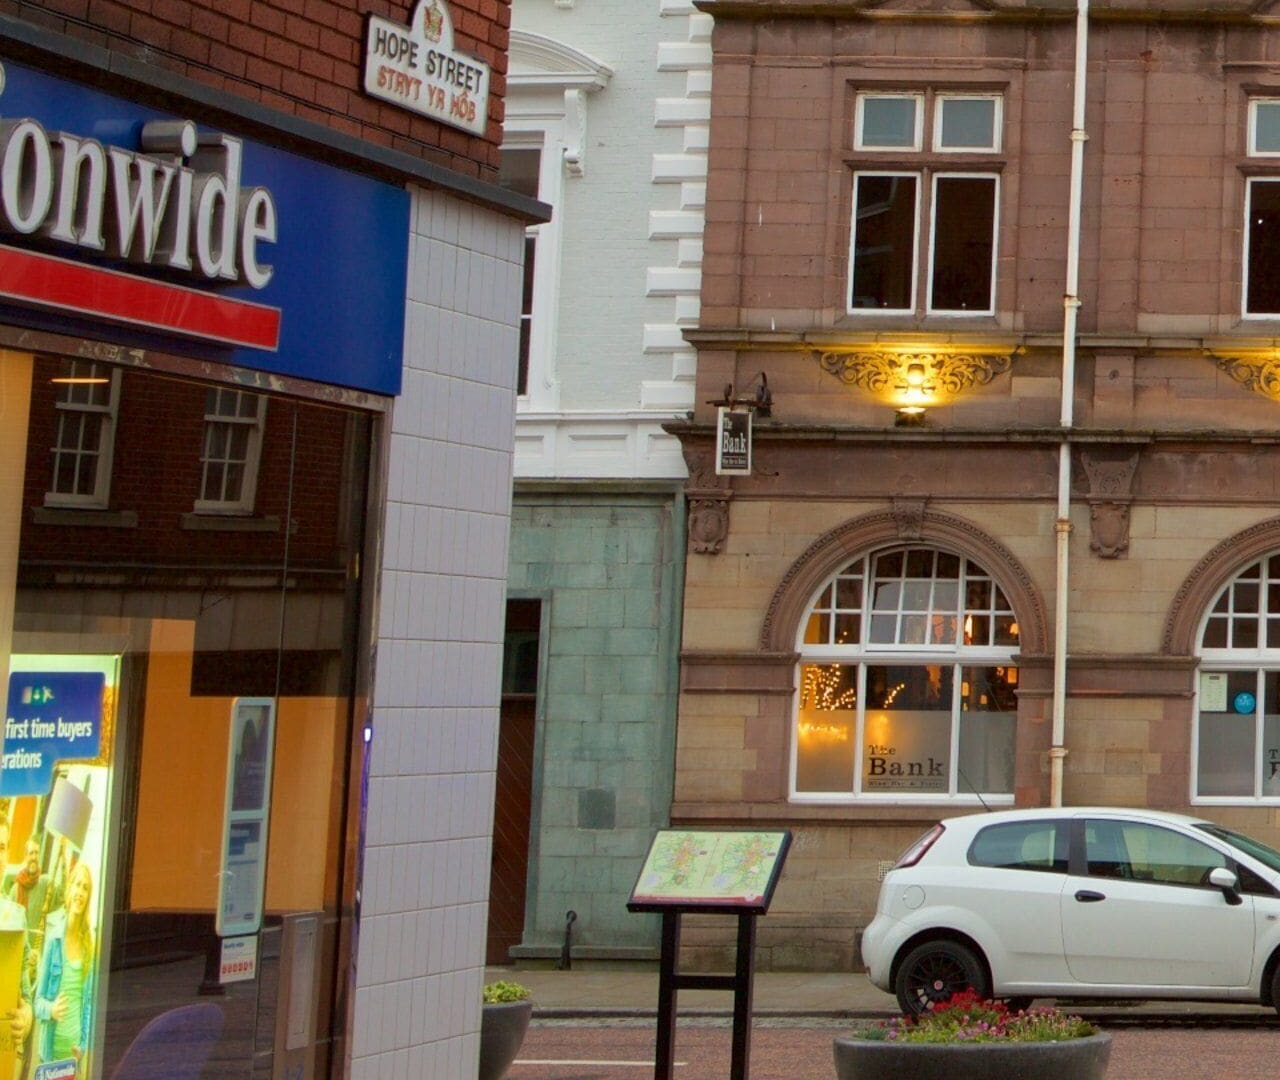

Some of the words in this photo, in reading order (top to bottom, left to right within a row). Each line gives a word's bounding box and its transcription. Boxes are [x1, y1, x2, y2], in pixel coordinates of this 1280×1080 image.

[373, 27, 419, 69] HOPE
[425, 49, 483, 95] STREET
[377, 65, 422, 101] STRYT
[428, 84, 445, 110] YR
[0, 118, 278, 290] onwide
[722, 431, 747, 453] Bank
[5, 718, 28, 739] first
[31, 717, 55, 738] time
[57, 717, 93, 742] buyers
[868, 744, 896, 755] The
[868, 756, 945, 776] Bank
